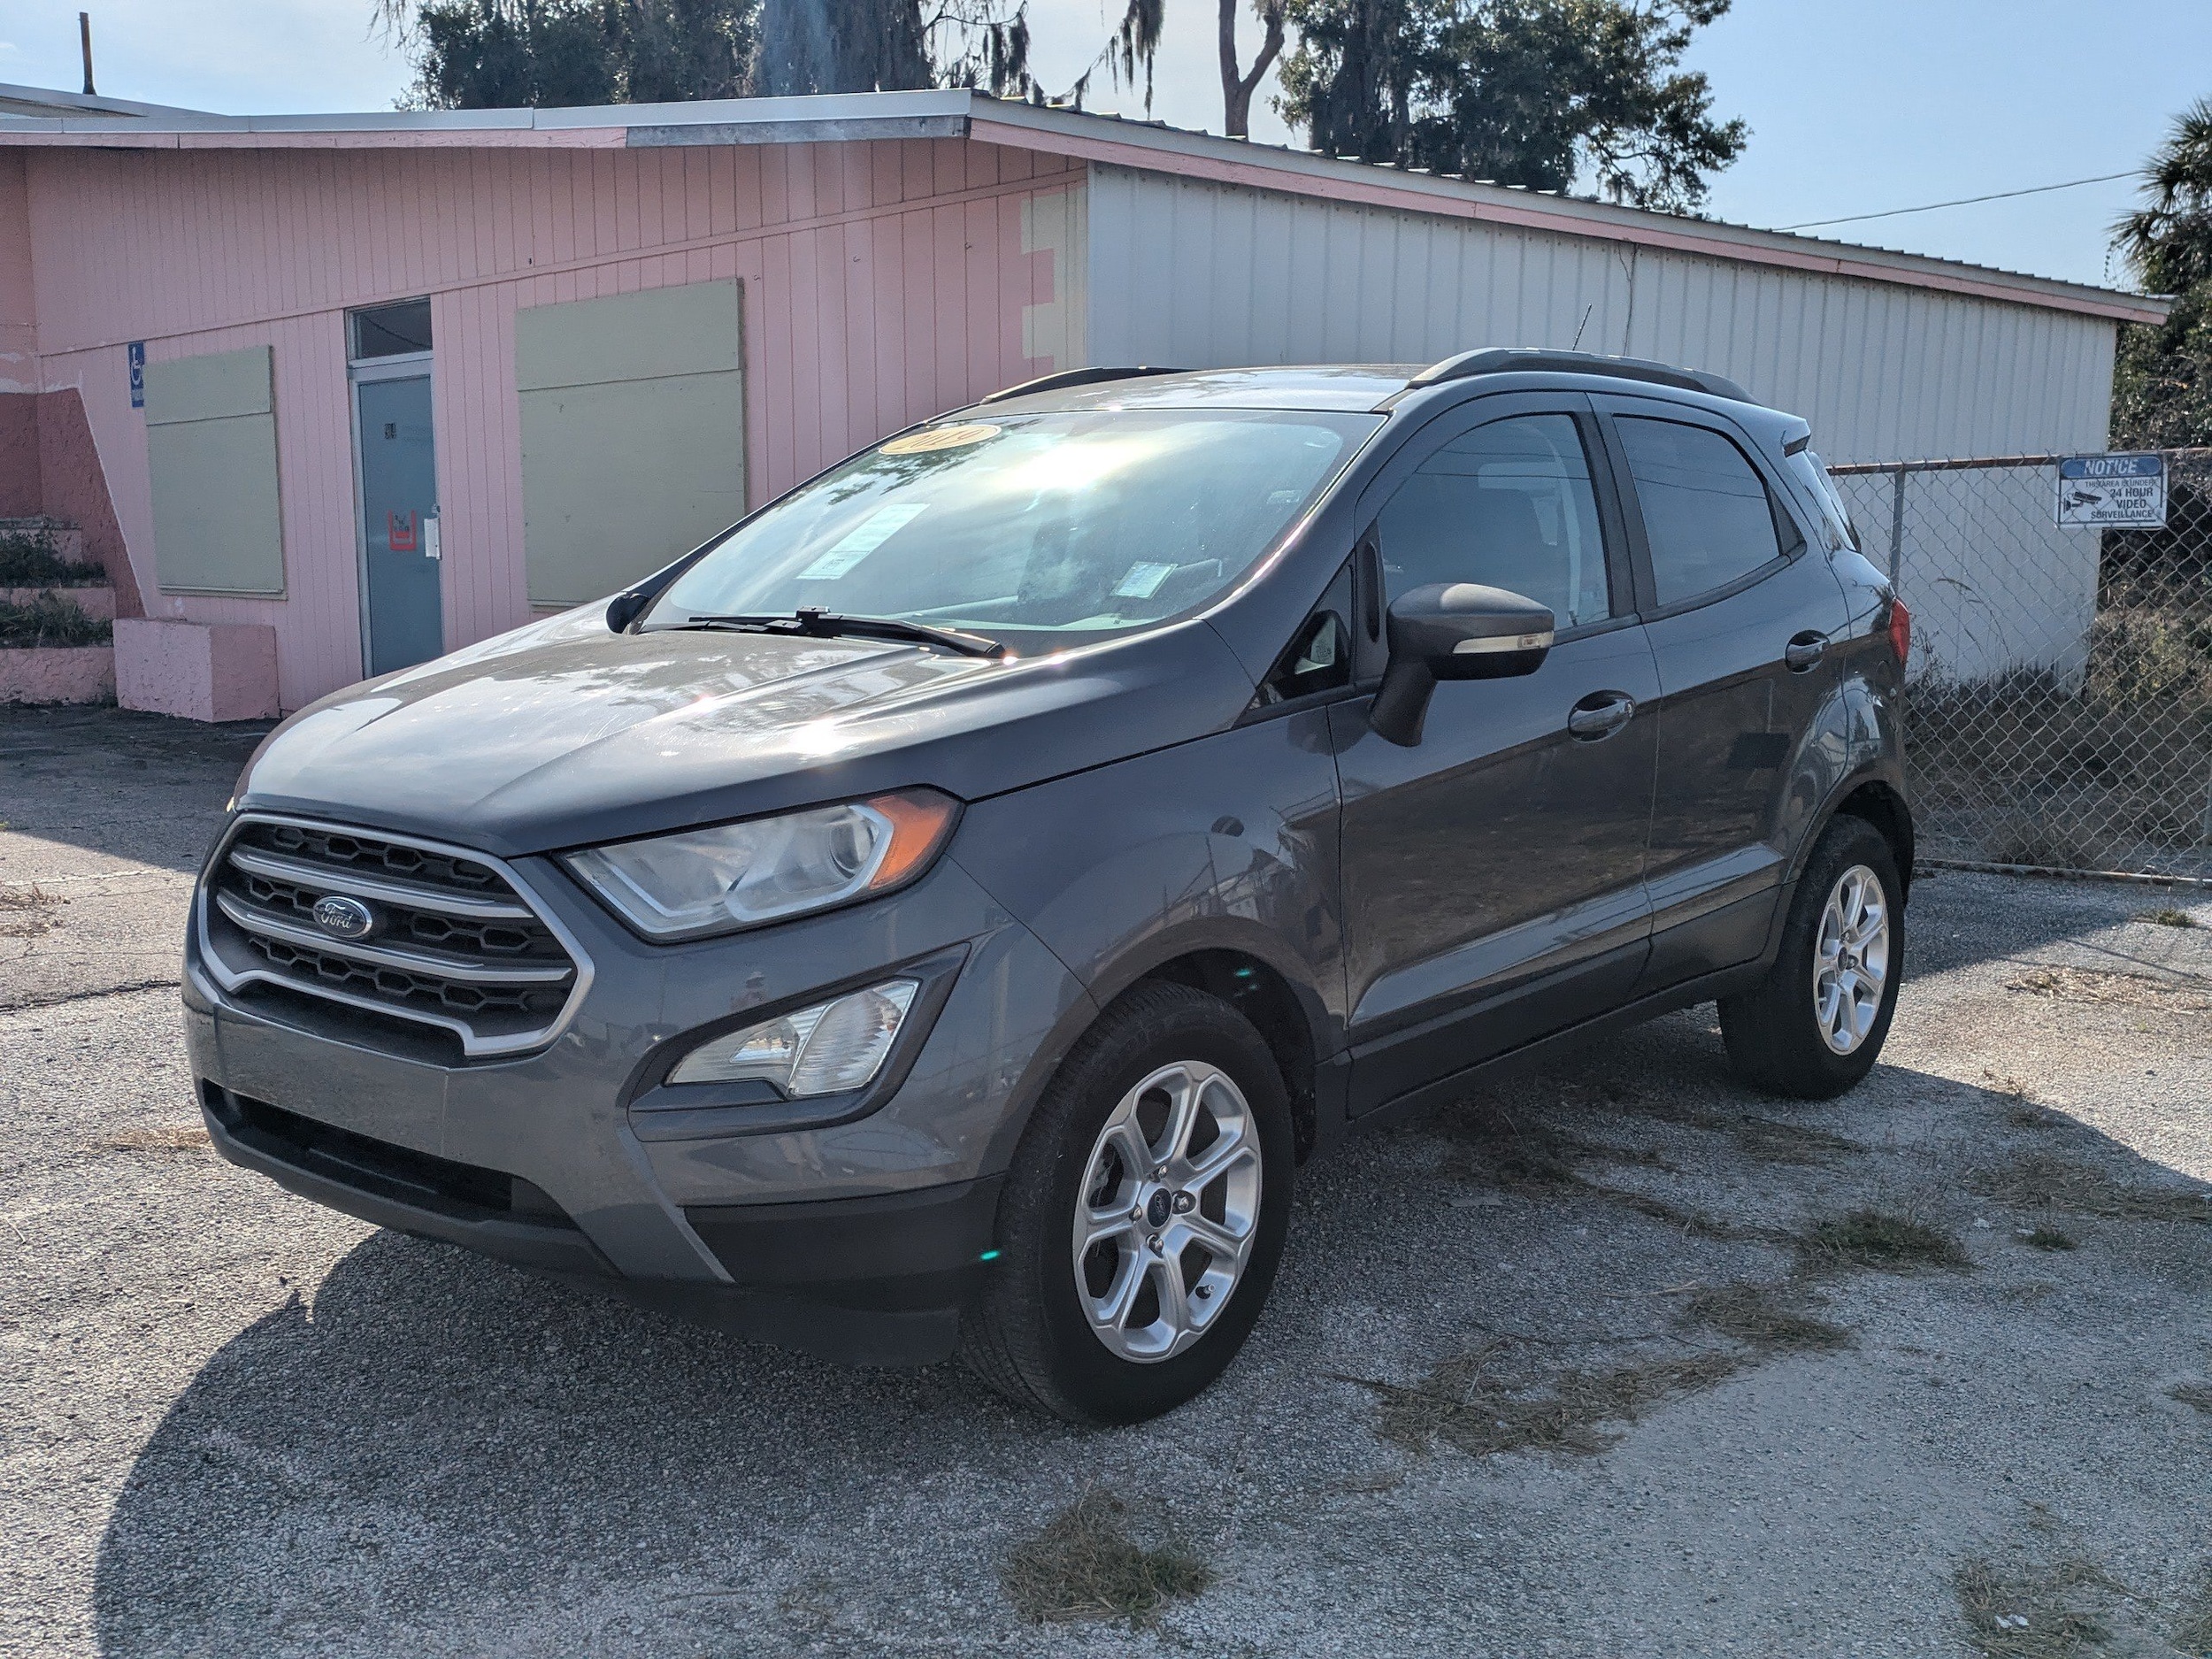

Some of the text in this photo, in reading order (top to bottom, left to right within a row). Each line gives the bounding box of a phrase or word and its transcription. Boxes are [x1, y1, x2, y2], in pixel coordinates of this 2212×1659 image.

[2084, 458, 2139, 475] NOTICE
[2110, 487, 2154, 497] 24 HOUR
[2116, 499, 2147, 509] VIDEO
[2091, 510, 2153, 518] SURVEILLANCE
[321, 902, 353, 928] Ford
